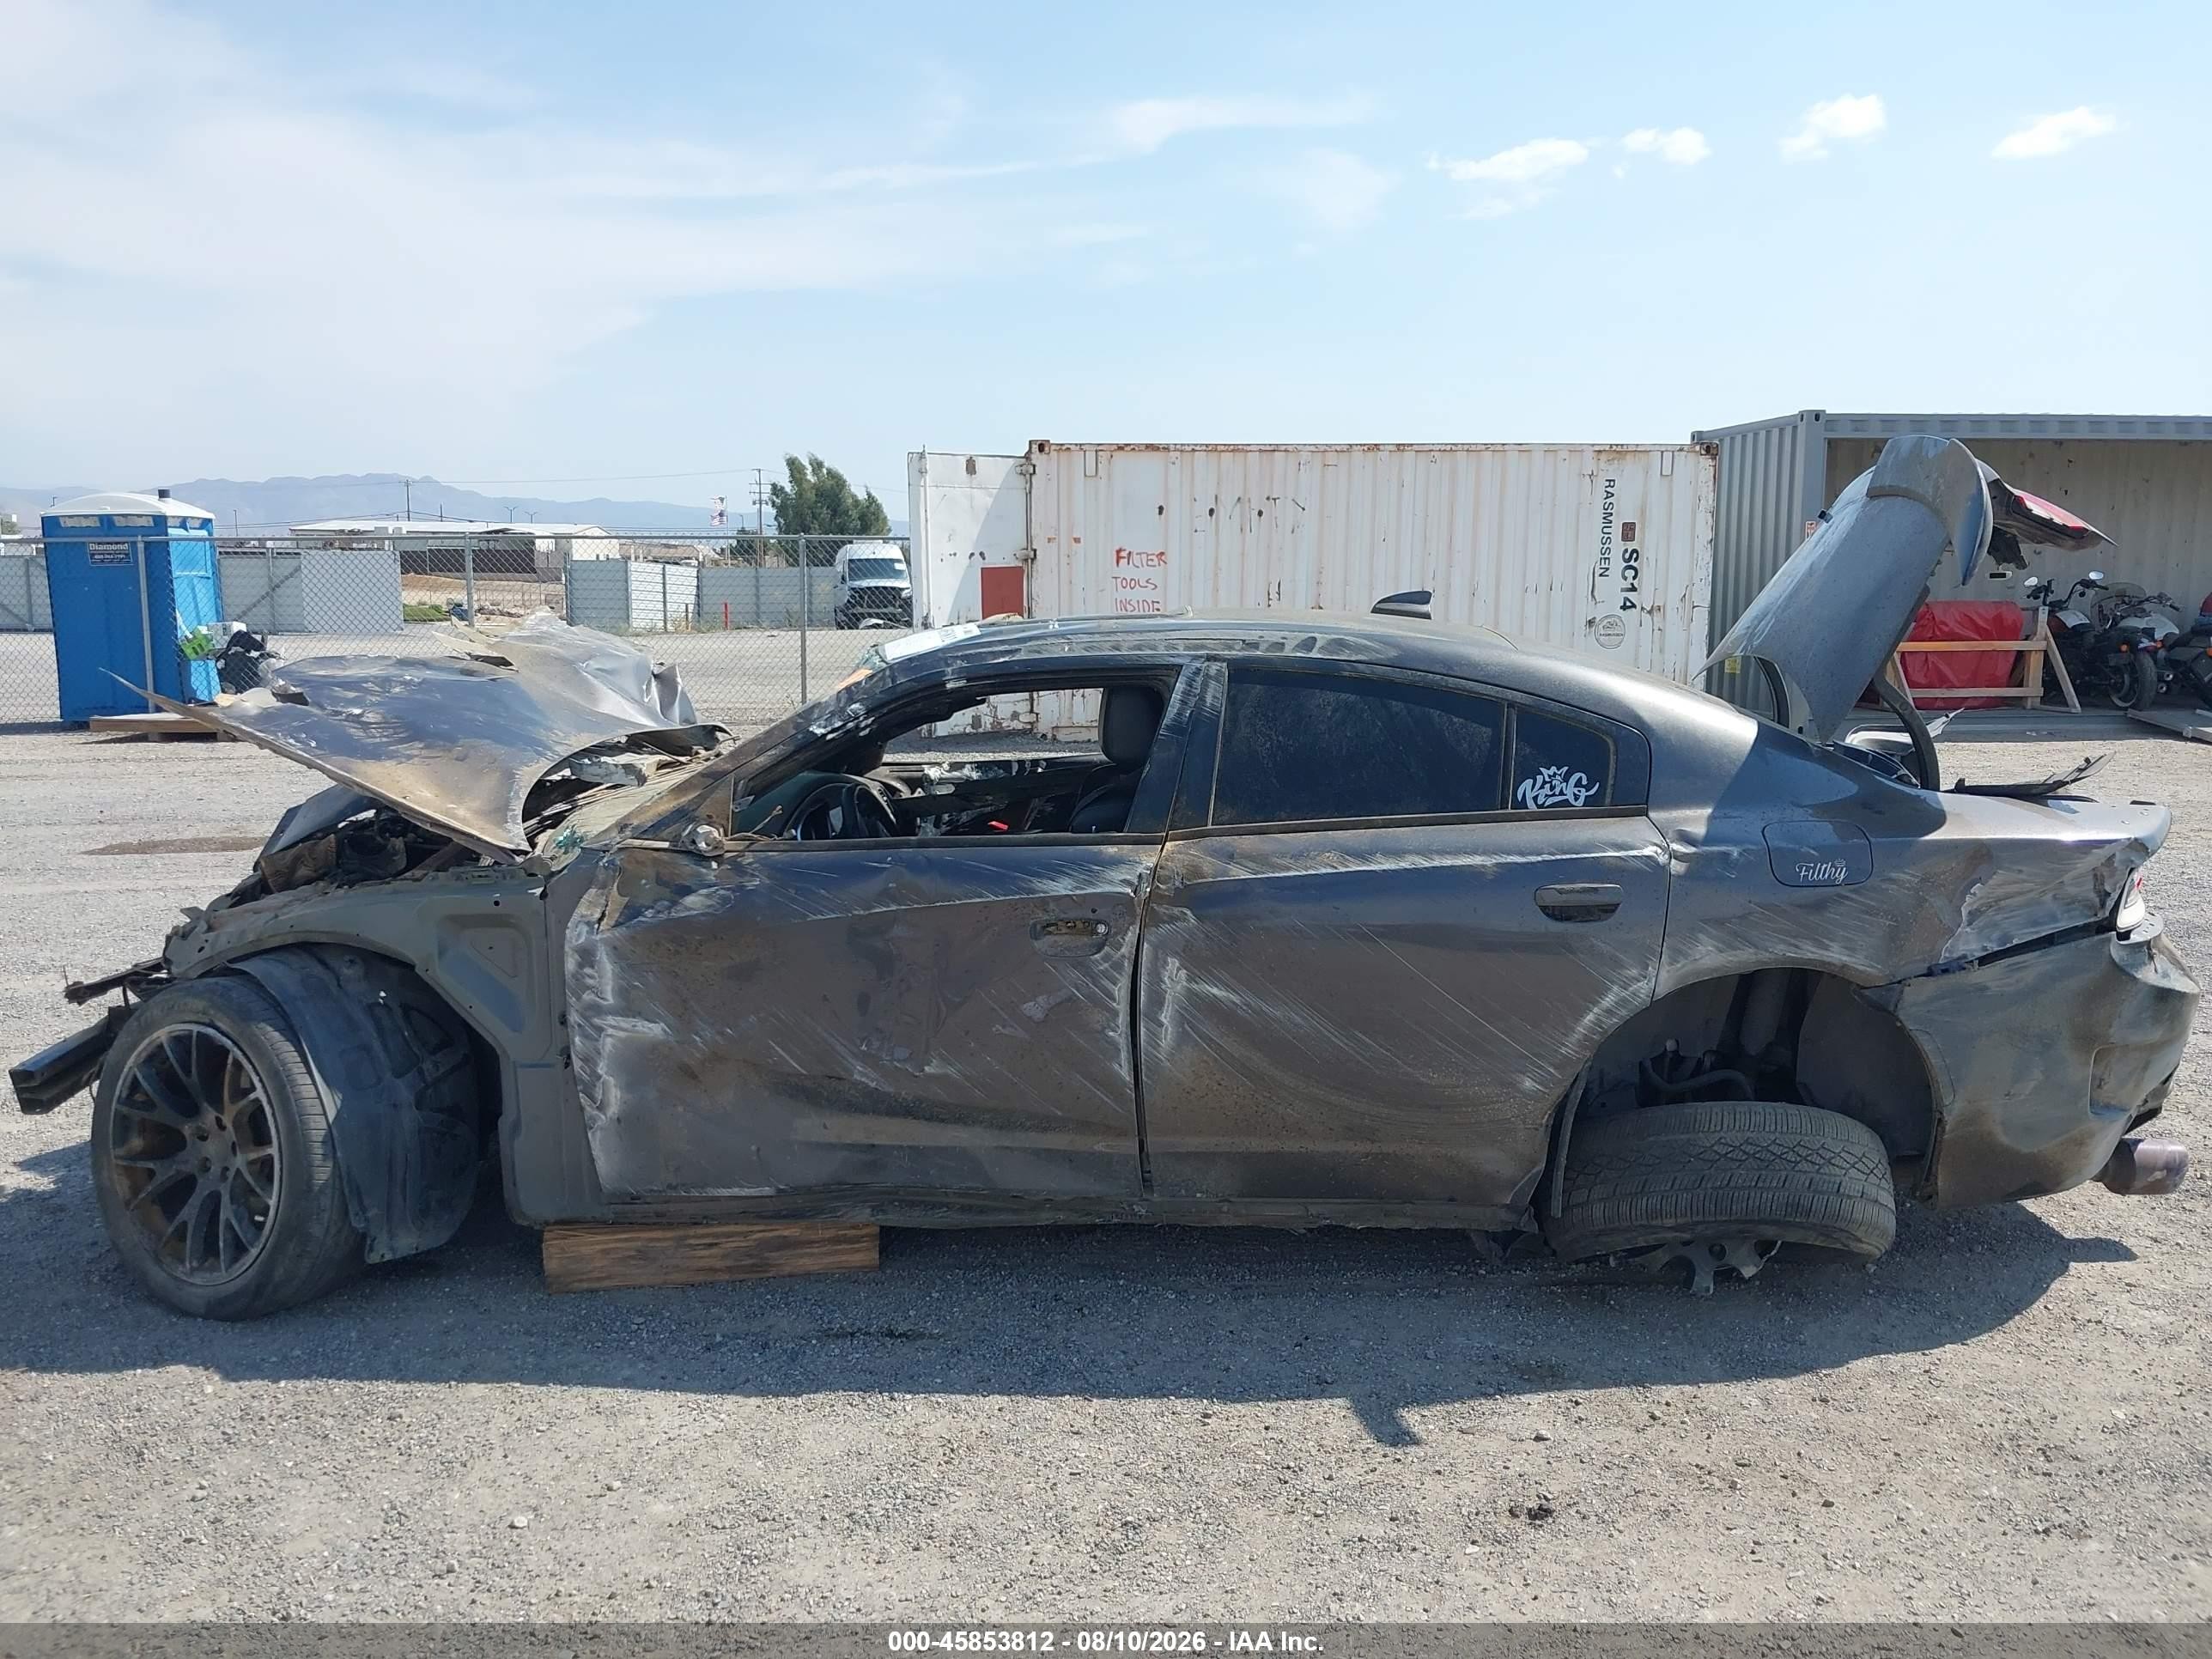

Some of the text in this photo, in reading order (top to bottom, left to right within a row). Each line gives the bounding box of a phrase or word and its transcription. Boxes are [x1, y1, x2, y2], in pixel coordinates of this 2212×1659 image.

[1599, 478, 1616, 578] RASMUSSEN
[1115, 547, 1168, 568] FILTER
[1111, 576, 1158, 592] TOOLS
[1620, 547, 1640, 612] SC14
[1115, 598, 1161, 613] INSIDE
[1796, 861, 1849, 884] Filthy
